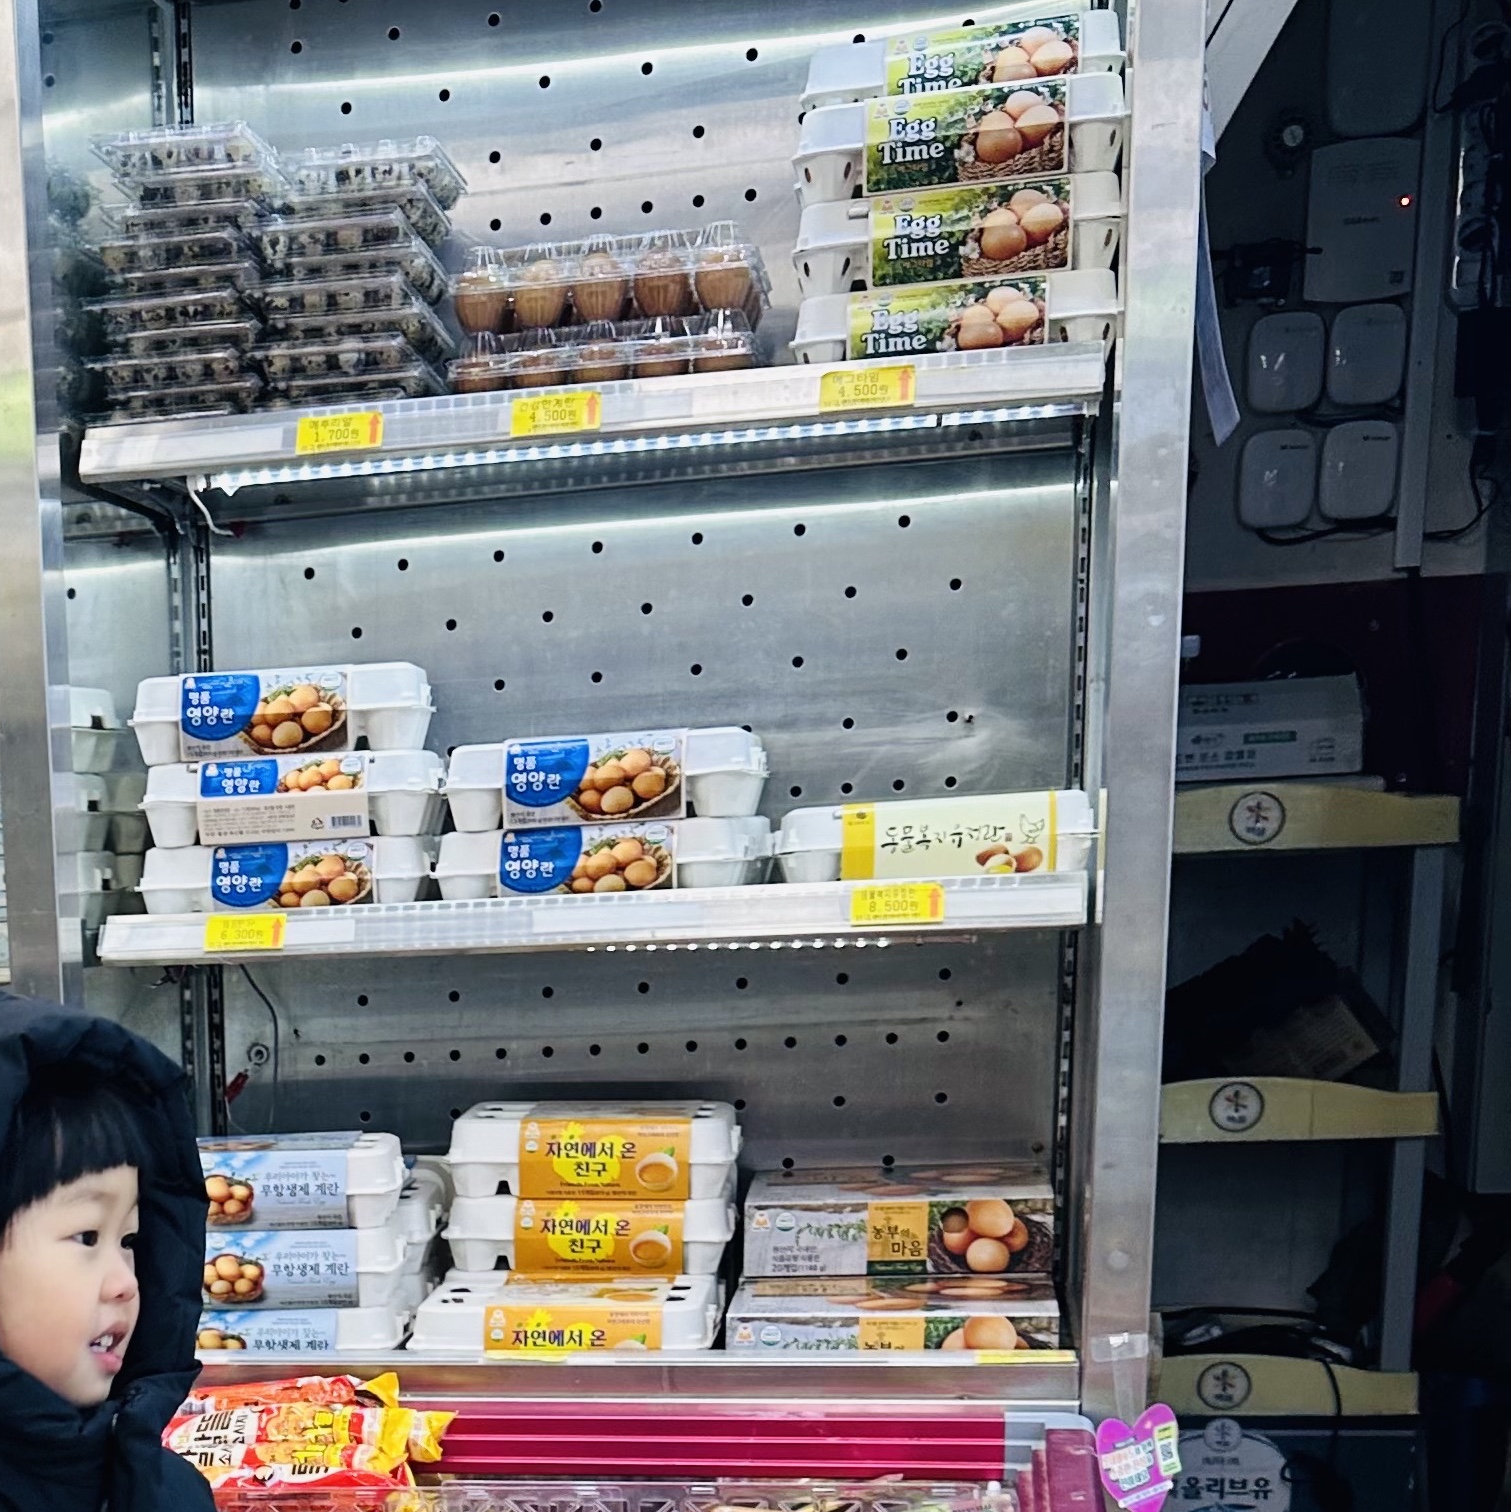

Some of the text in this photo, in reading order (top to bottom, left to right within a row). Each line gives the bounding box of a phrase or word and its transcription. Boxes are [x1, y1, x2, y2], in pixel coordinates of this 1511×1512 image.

[908, 52, 955, 79] Egg
[898, 77, 962, 94] Time
[889, 117, 937, 143] Egg
[878, 141, 945, 165] Time
[894, 214, 942, 239] Egg
[883, 238, 950, 260] Time
[872, 308, 920, 334] Egg
[861, 333, 927, 355] Time
[186, 706, 235, 726] 영양란
[222, 778, 261, 794] 영양란
[511, 771, 562, 792] 영양란
[505, 859, 555, 880] 영양란
[216, 874, 263, 894] 영양란
[545, 1141, 637, 1159] 자연에서 온
[573, 1161, 608, 1177] 친구
[261, 1181, 340, 1197] 무항생제 계란
[540, 1218, 631, 1236] 자연에서 온
[568, 1237, 603, 1254] 친구
[891, 1240, 924, 1257] 마음
[271, 1262, 350, 1277] 무항생제 계란
[511, 1329, 607, 1346] 자연에서 온
